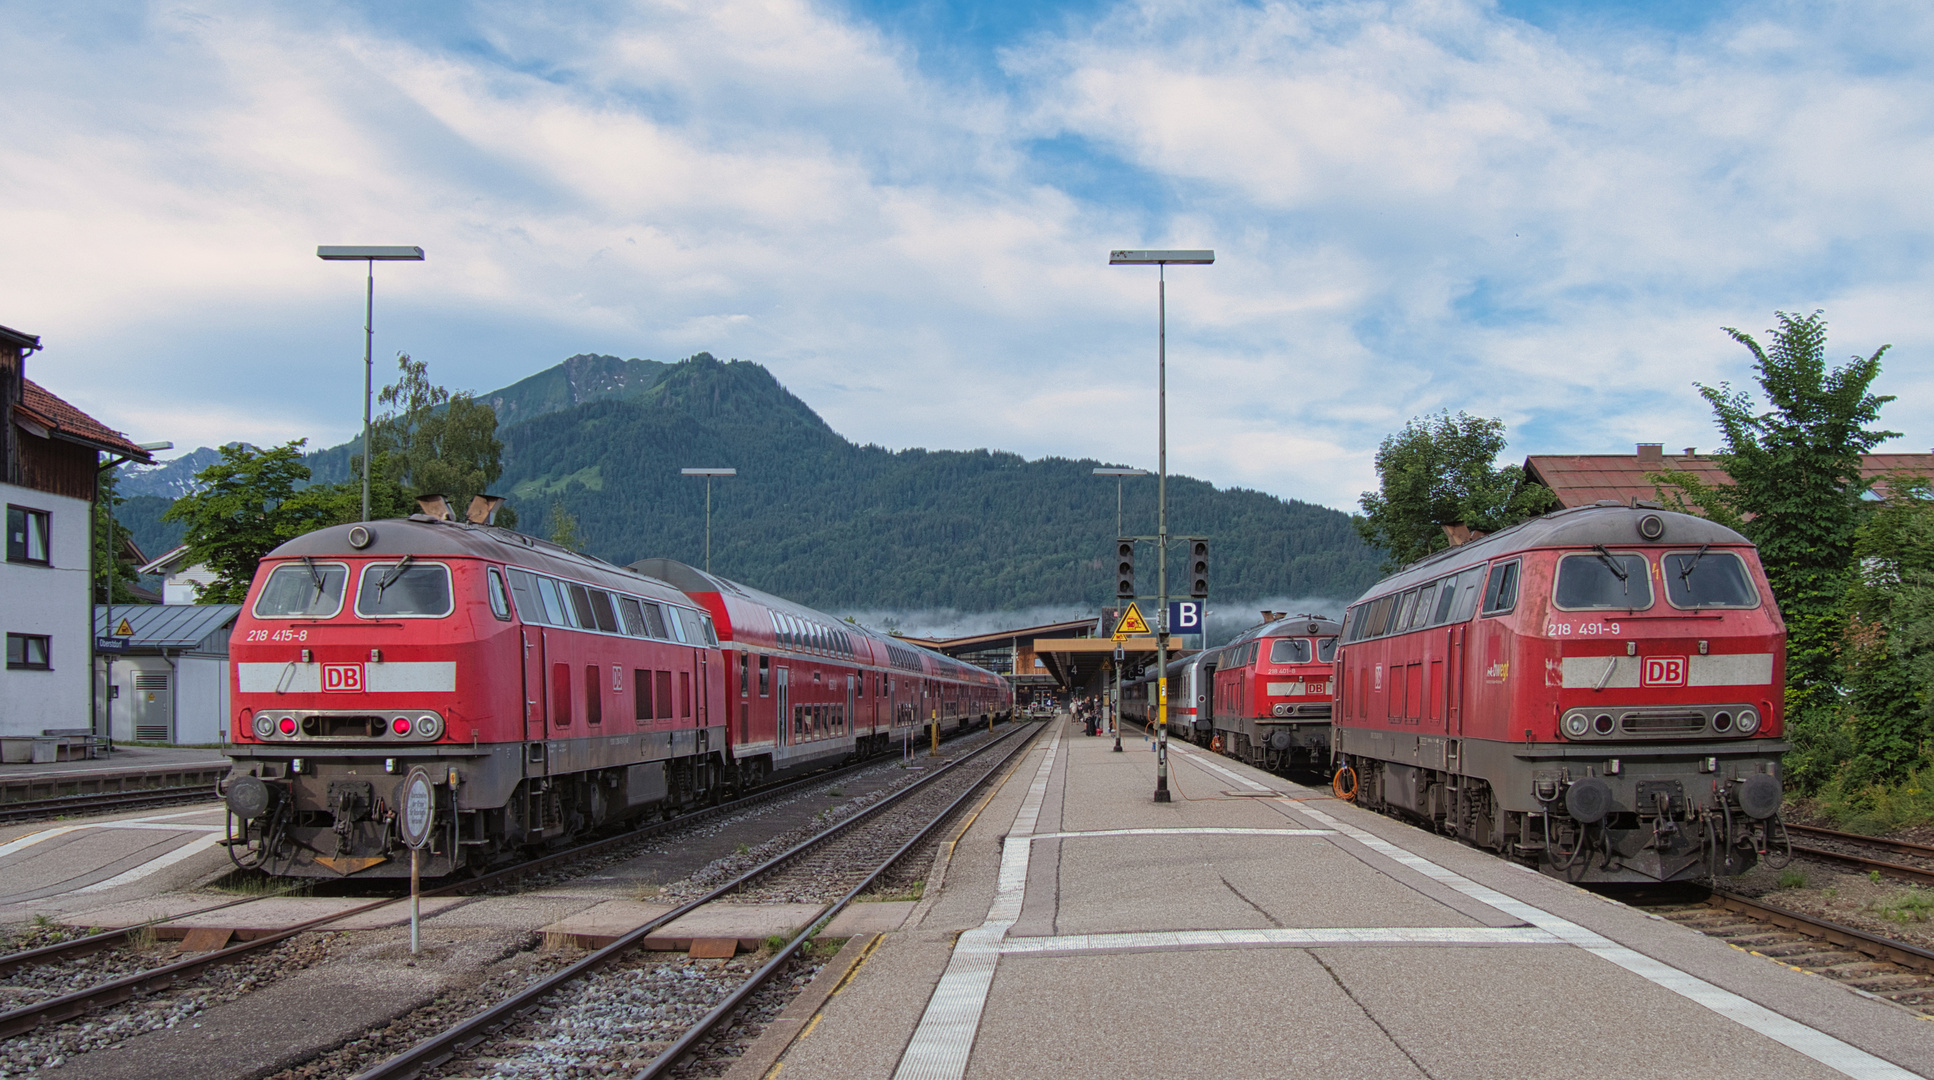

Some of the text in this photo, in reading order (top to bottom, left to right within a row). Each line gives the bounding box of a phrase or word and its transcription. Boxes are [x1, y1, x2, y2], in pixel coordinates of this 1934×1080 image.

[1179, 602, 1198, 627] B
[1548, 622, 1620, 636] 218 491-9
[246, 630, 308, 641] 218 415-8
[99, 638, 123, 649] Oberstdorf
[1071, 665, 1077, 675] 4
[1137, 664, 1144, 675] 5
[1648, 661, 1680, 682] DB
[327, 668, 358, 687] DB
[1308, 684, 1323, 693] DB
